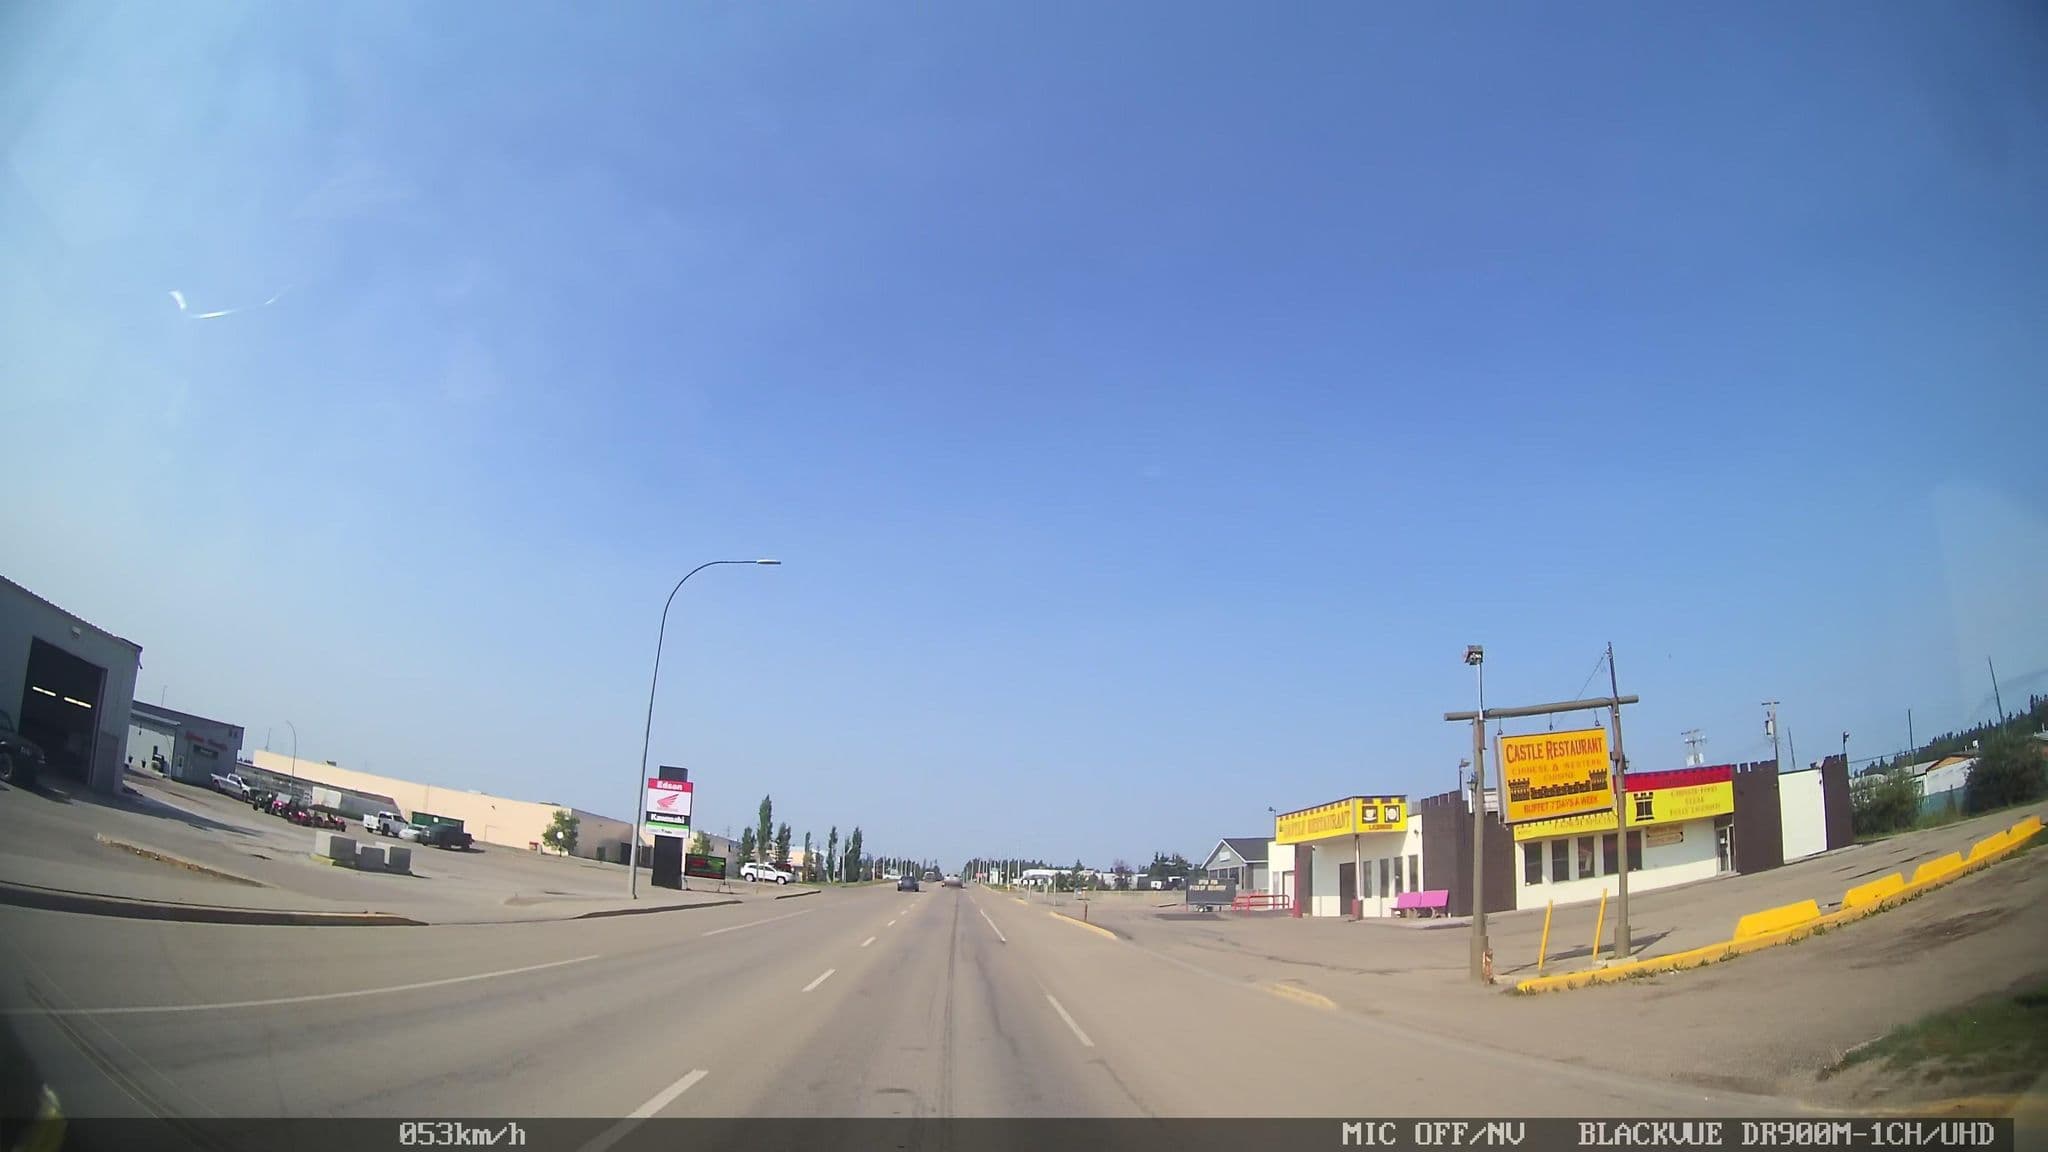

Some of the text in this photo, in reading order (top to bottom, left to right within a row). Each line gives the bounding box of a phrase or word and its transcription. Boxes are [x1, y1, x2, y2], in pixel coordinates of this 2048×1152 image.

[1506, 737, 1603, 763] CASTLE RESTAURANT
[656, 780, 683, 791] Edson
